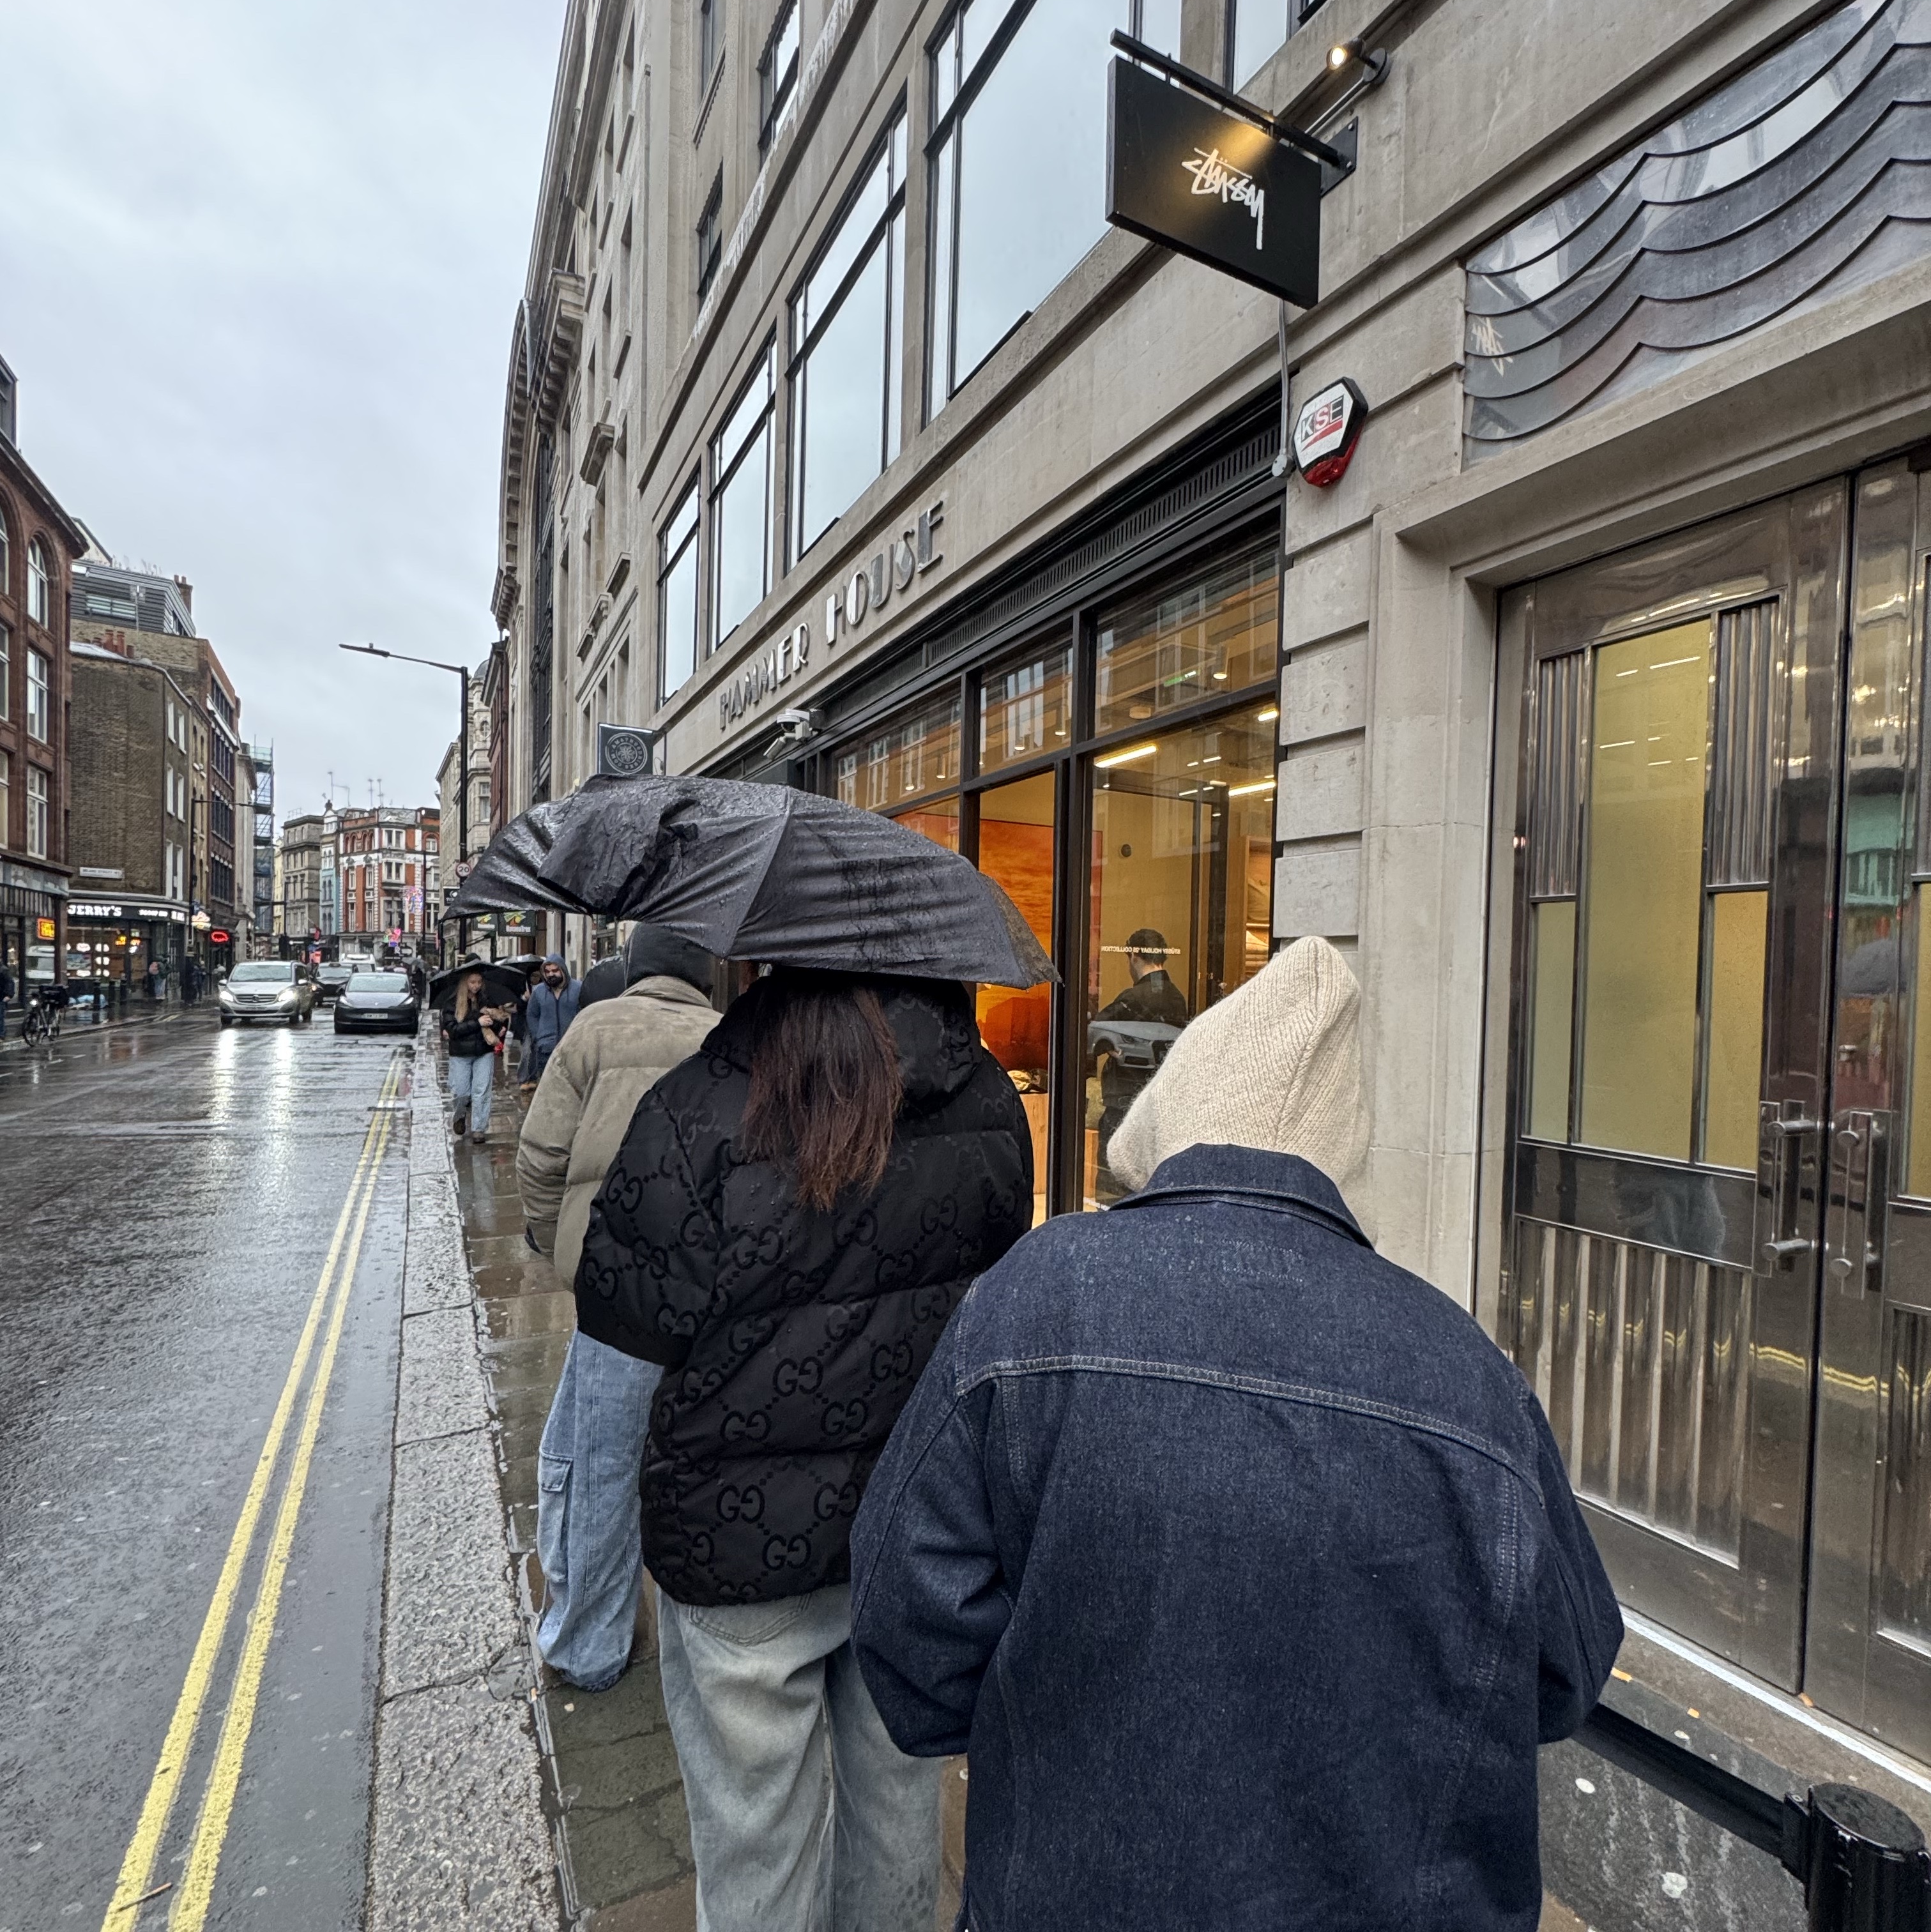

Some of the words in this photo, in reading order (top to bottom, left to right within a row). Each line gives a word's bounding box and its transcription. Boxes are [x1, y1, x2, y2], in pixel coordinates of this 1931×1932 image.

[1301, 397, 1343, 442] KSE
[719, 621, 811, 730] HAMMER
[825, 500, 944, 646] HOUSE
[67, 904, 122, 917] JERRY'S
